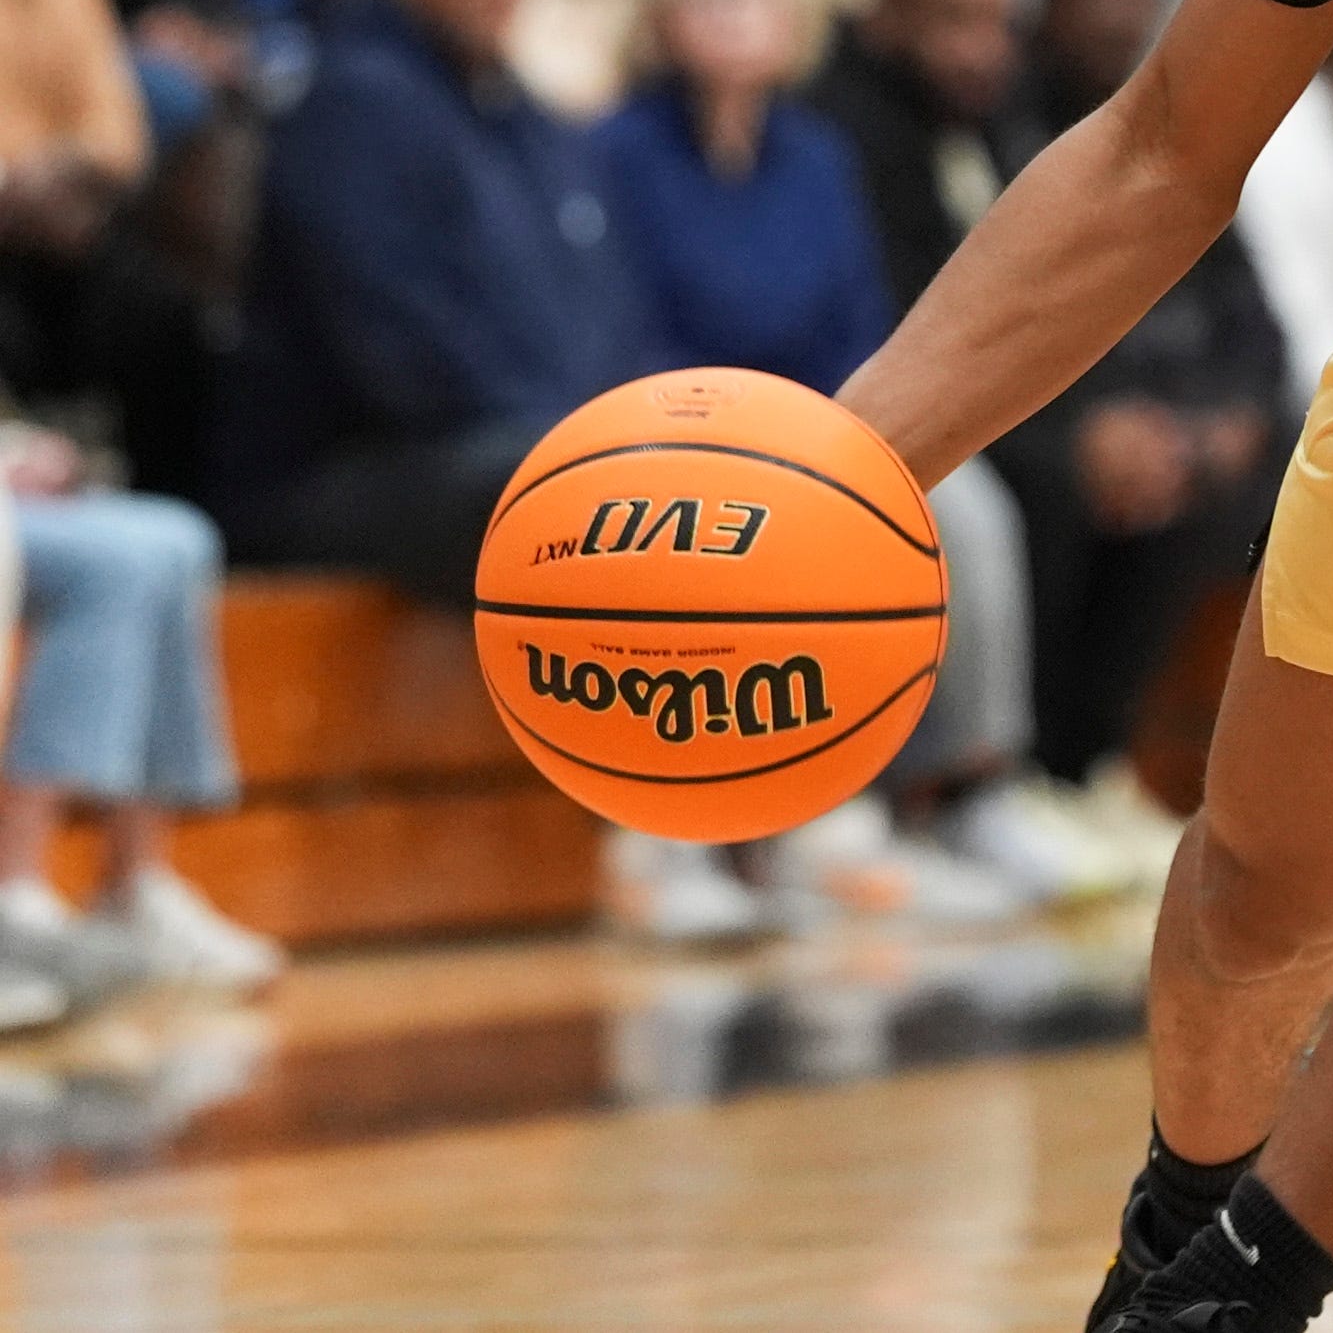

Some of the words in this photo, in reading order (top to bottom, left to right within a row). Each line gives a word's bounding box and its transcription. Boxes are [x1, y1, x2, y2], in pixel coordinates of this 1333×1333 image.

[578, 497, 770, 561] EVO
[529, 538, 578, 567] NXT
[590, 641, 625, 655] BALL
[629, 646, 672, 658] GAME
[677, 645, 736, 658] INDOOR
[524, 641, 836, 745] Wilson
